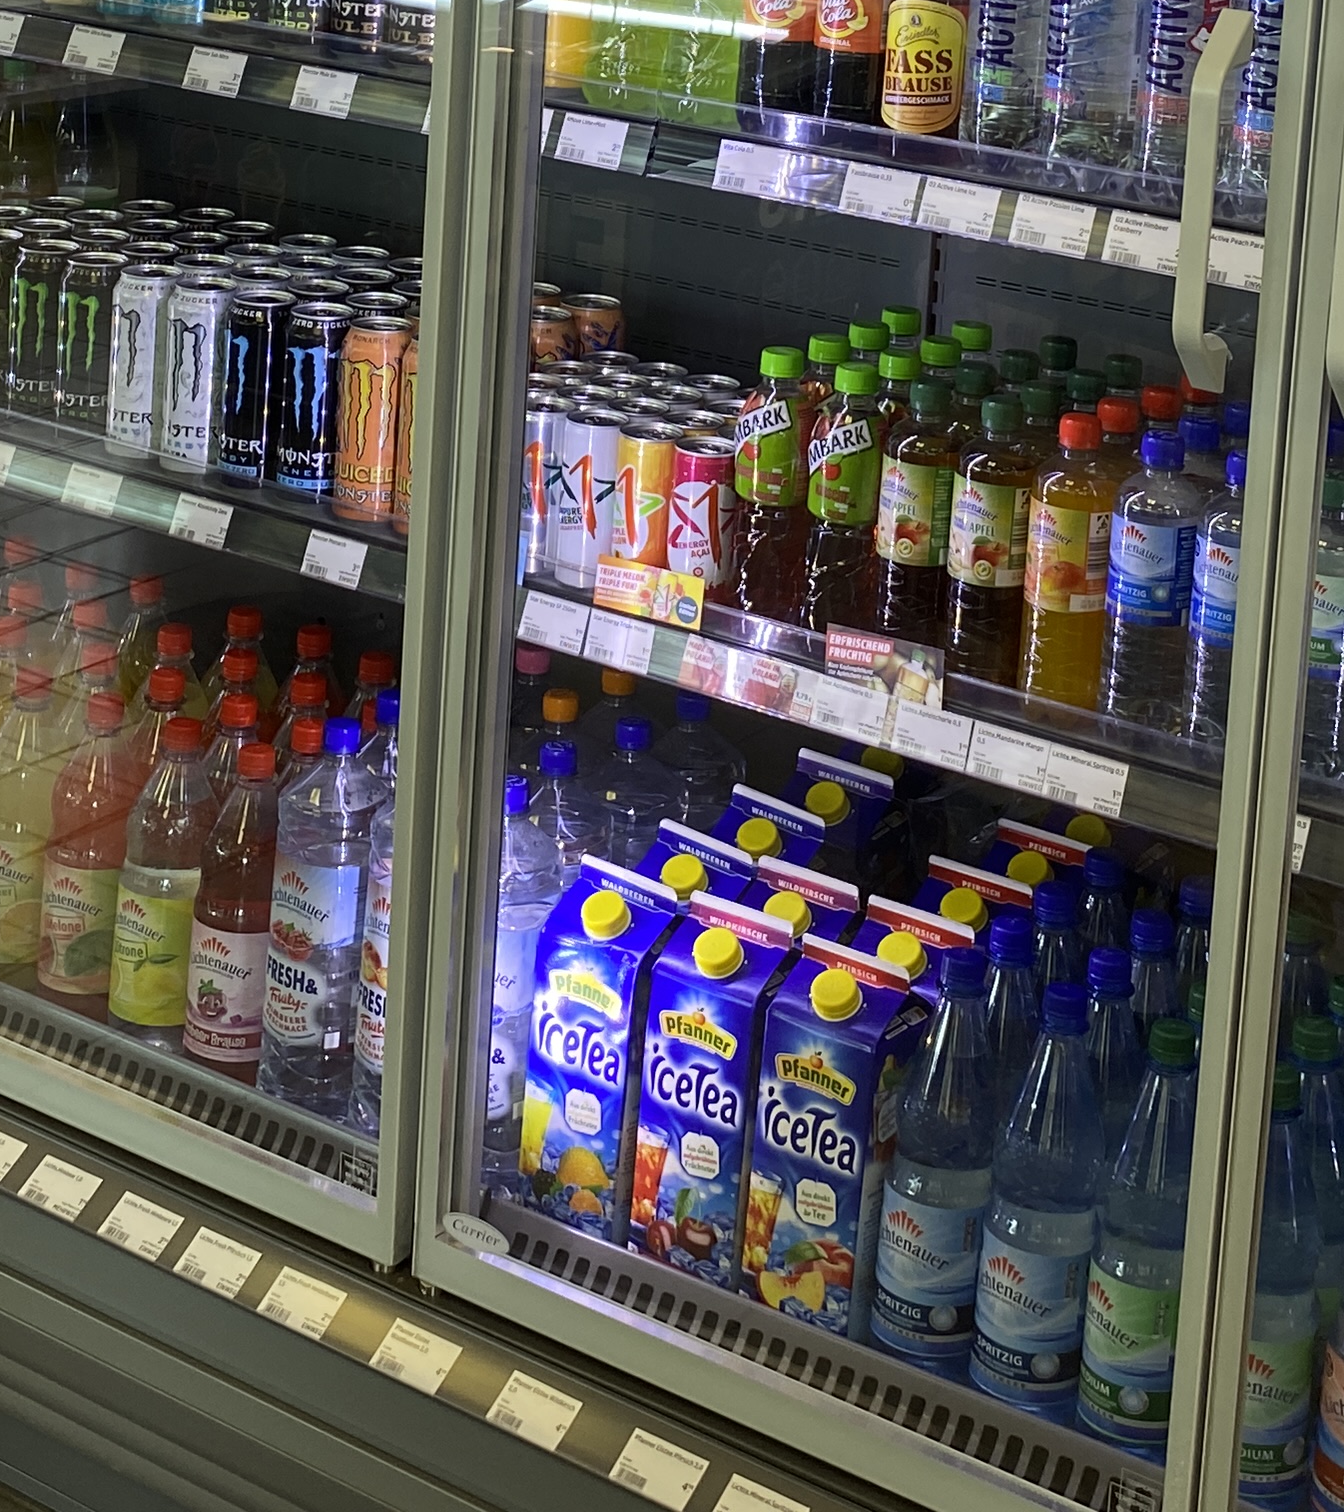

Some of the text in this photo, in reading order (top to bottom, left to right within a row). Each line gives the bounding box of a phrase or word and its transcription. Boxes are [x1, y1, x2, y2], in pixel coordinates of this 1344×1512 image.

[820, 7, 854, 24] Cola
[885, 47, 954, 74] FASS
[885, 75, 953, 93] BRAUSE
[829, 647, 872, 663] FRUCHTIG
[752, 806, 803, 833] WALDBEEREN
[678, 841, 731, 870] WALDBEEREN
[600, 877, 655, 906] WALDBEEREN
[778, 878, 834, 904] WILDKIRSCHE
[710, 914, 768, 941] WILDKIRSCHE
[901, 922, 941, 942] PFIRSICH
[837, 960, 877, 981] PFIRSICH
[663, 1011, 734, 1057] pfanner
[780, 1056, 852, 1100] pfanner
[450, 1217, 501, 1250] Carrier
